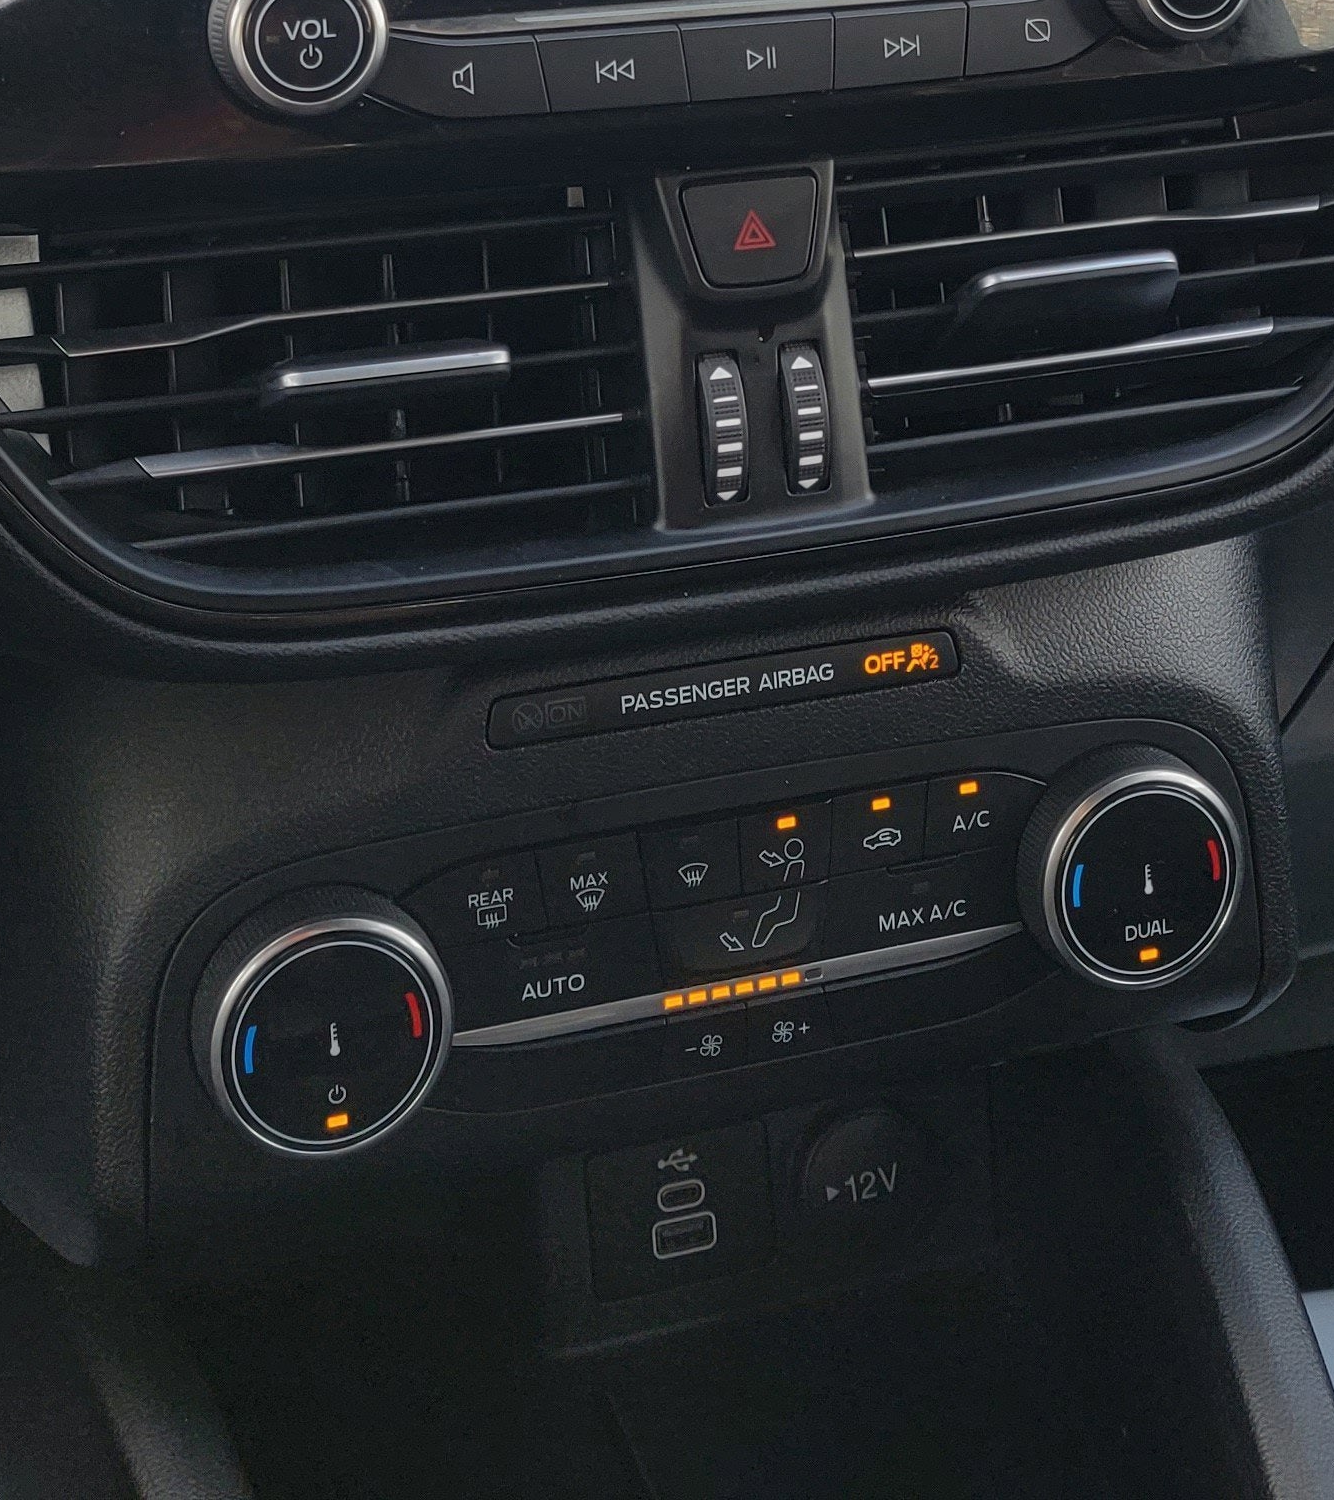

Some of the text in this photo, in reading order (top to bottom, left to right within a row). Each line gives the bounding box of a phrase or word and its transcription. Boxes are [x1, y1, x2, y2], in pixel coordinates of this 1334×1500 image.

[283, 19, 337, 41] VOL
[864, 649, 906, 674] OFF
[620, 662, 835, 715] PASSENGER AIRBAG
[951, 809, 991, 833] A/C
[570, 871, 609, 891] MAX
[467, 887, 515, 909] REAR
[877, 899, 967, 933] MAX A/C
[1124, 918, 1174, 942] DUAL
[520, 973, 586, 1002] AUTO
[844, 1161, 898, 1202] 12V
